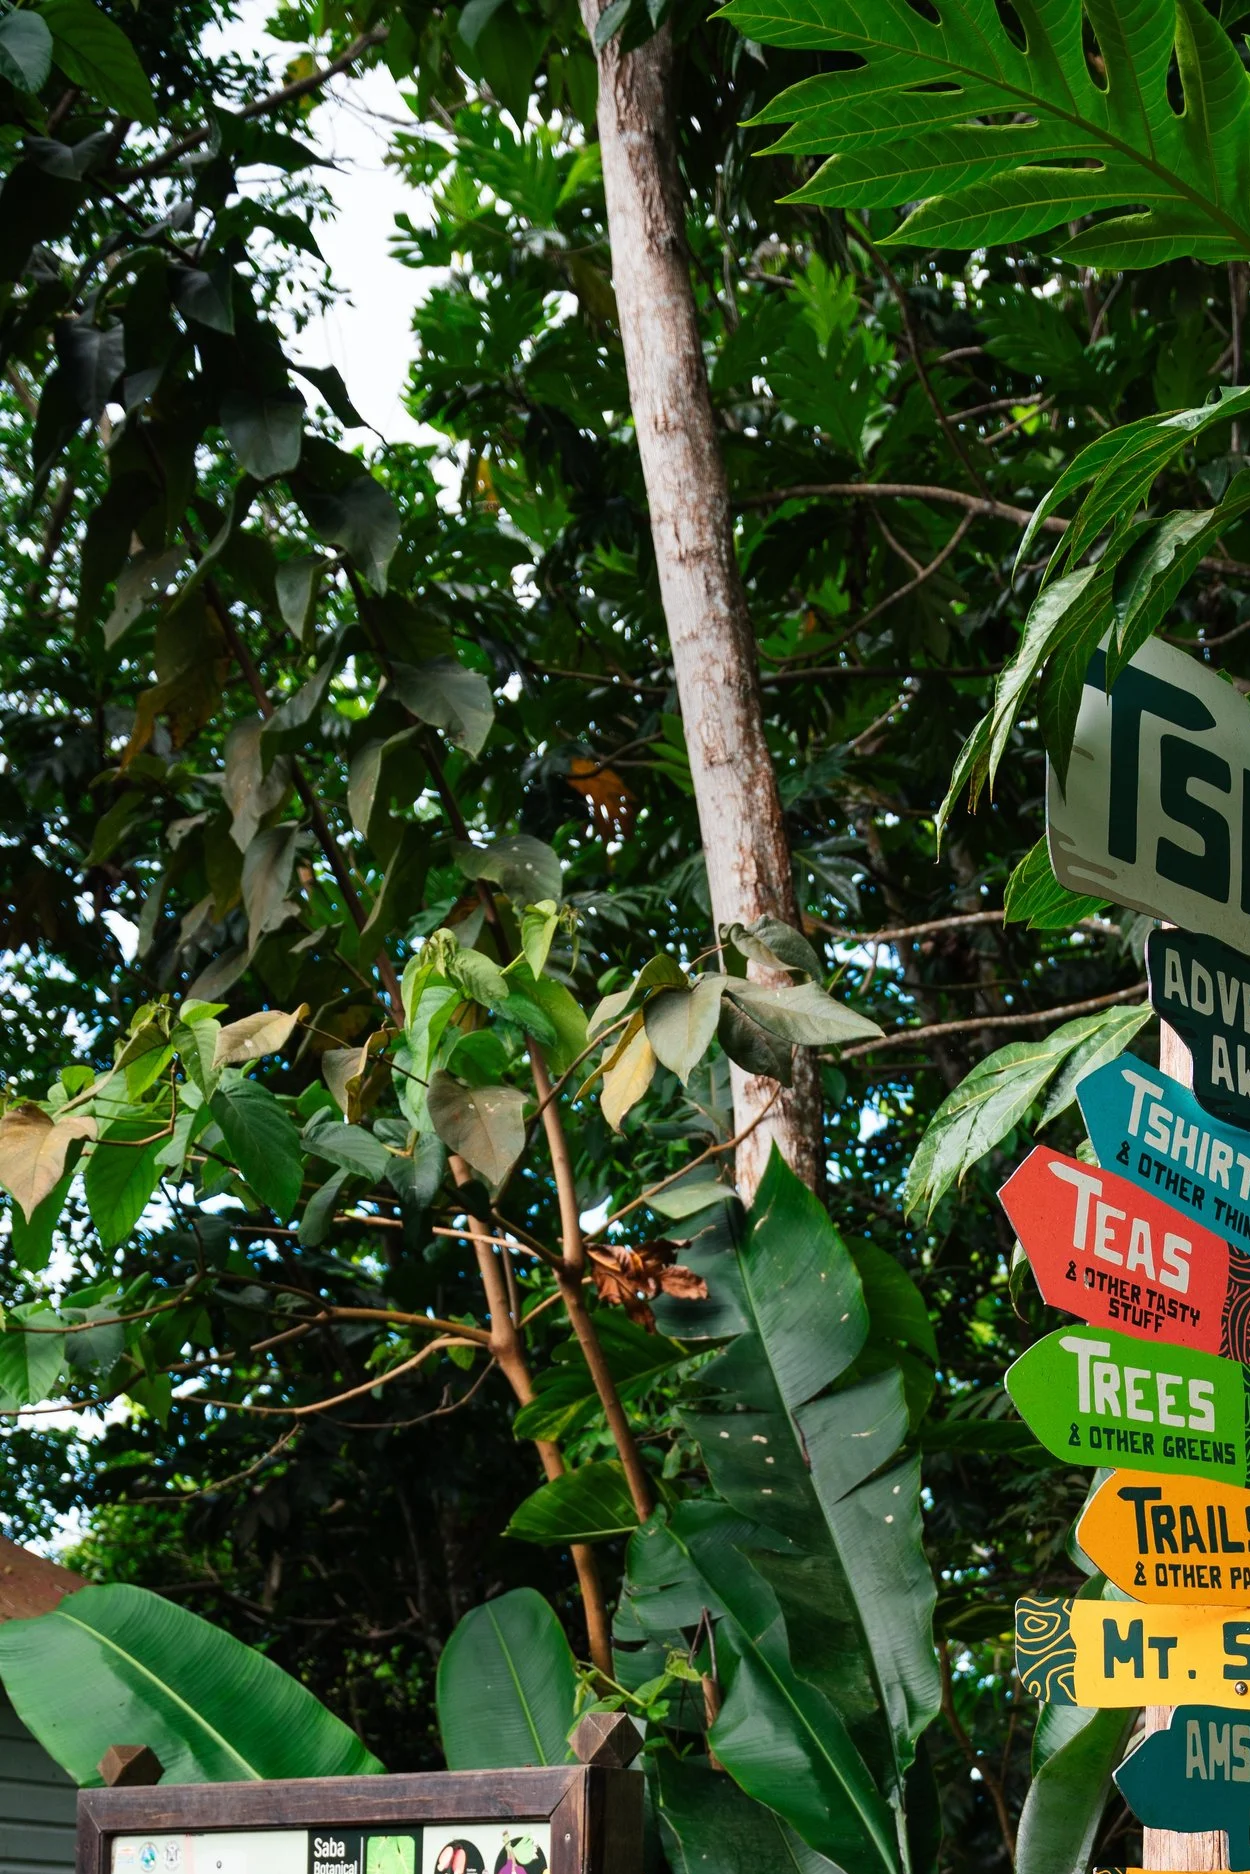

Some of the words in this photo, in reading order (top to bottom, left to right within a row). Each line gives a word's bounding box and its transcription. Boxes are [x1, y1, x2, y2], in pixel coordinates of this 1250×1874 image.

[1116, 1140, 1130, 1167] &
[1138, 1156, 1206, 1212] OTHER
[1048, 1161, 1193, 1295] TEAS
[1084, 1267, 1142, 1306] OTHER
[1147, 1288, 1201, 1328] TASTY
[1108, 1303, 1166, 1335] STUFF
[1059, 1335, 1216, 1433] TREES
[1089, 1430, 1155, 1457] OTHER
[1162, 1440, 1236, 1466] GREENS
[1155, 1564, 1222, 1589] OTHER
[314, 1837, 345, 1858] Saba
